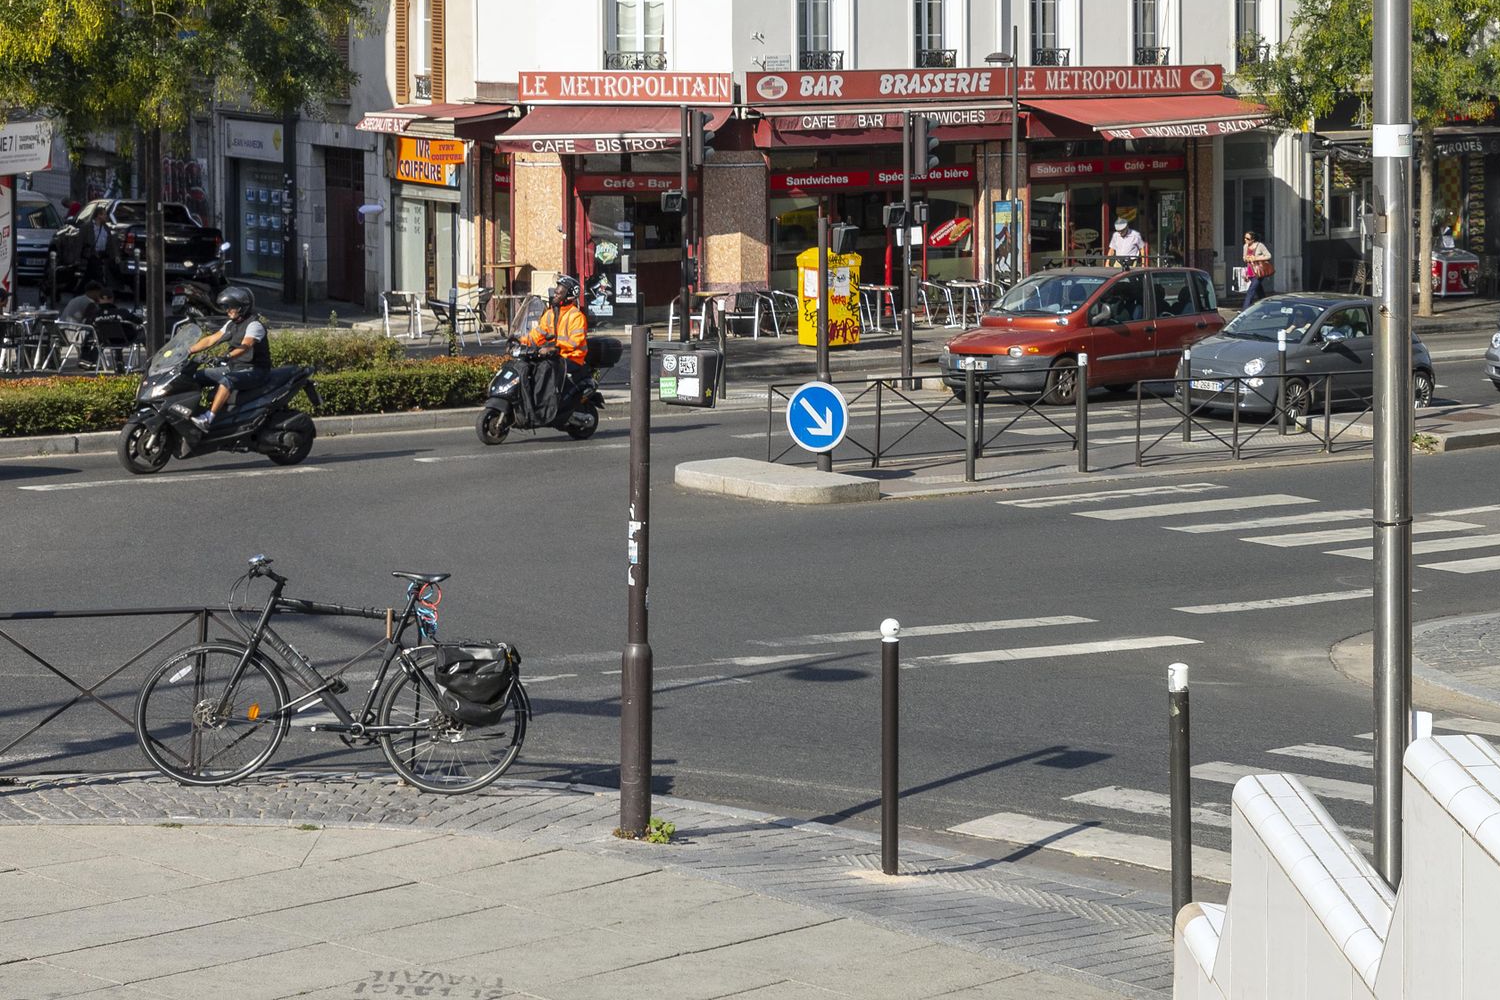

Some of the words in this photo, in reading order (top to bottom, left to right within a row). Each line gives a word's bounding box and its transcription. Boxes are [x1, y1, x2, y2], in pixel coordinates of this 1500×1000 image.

[521, 75, 548, 96] LE
[559, 74, 730, 98] METROPOLITAIN
[799, 74, 844, 98] BAR
[879, 71, 992, 96] BRASSERIE
[1017, 70, 1035, 90] LE
[1045, 68, 1182, 91] METROPOLITAIN
[802, 114, 836, 129] CAFE
[858, 113, 884, 128] BAR
[1109, 128, 1132, 139] BAR
[1142, 123, 1209, 138] LIMONADIER
[1218, 119, 1257, 134] SALON
[531, 139, 576, 154] CAFE
[595, 138, 667, 153] BISTROT
[399, 160, 442, 182] COIFFURE
[1036, 164, 1062, 175] Salon
[1064, 163, 1076, 174] de
[1077, 162, 1093, 173] thé
[1124, 160, 1145, 171] Café
[1152, 160, 1168, 170] Bar
[786, 173, 849, 186] Sandwiches
[929, 170, 942, 180] de
[943, 168, 969, 179] bière
[603, 177, 635, 190] Café
[648, 177, 673, 189] Bar
